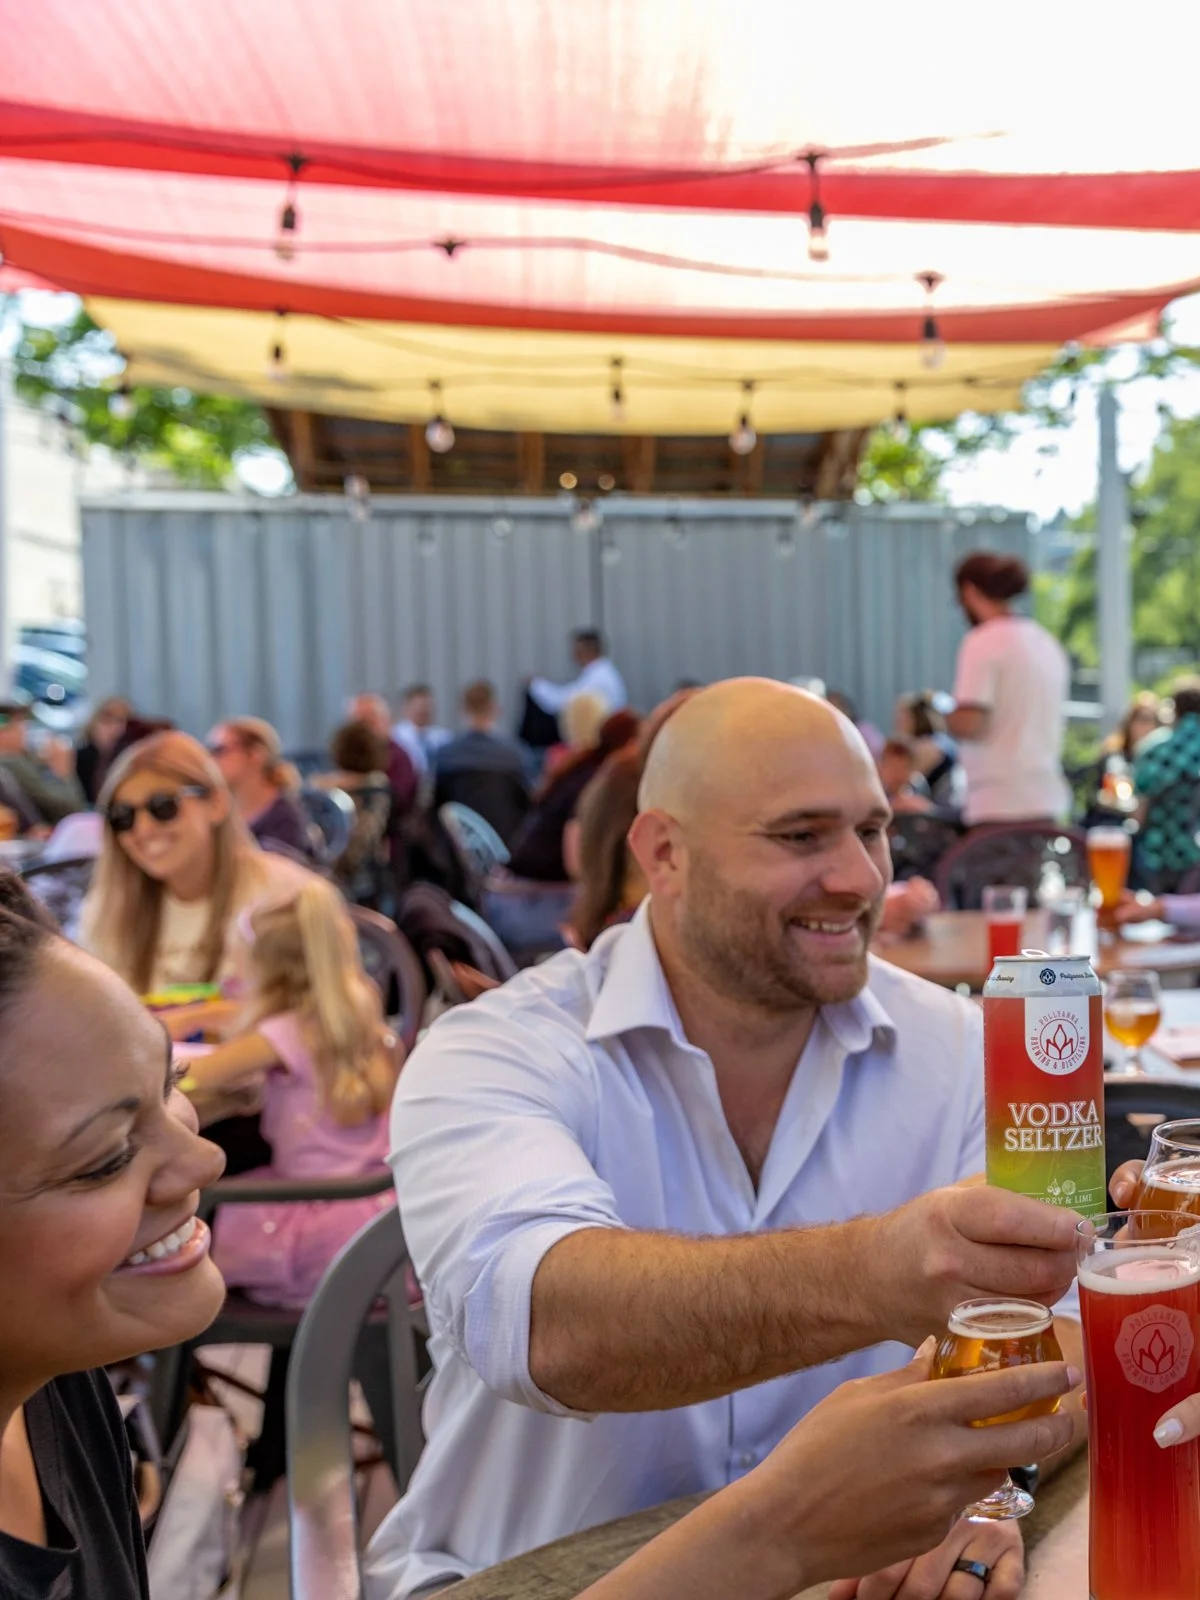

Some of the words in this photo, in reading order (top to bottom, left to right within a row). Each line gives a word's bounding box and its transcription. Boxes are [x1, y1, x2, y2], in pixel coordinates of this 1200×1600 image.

[1039, 1010, 1080, 1025] POLLYANNA
[1031, 1036, 1051, 1067] BREWING
[1061, 1036, 1086, 1069] DISTILLING
[1007, 1099, 1100, 1127] VODKA
[1004, 1125, 1103, 1152] SELTZER
[1065, 1196, 1072, 1204] &
[1074, 1193, 1093, 1204] LIME
[1129, 1310, 1182, 1331] POLLYANNA
[1121, 1352, 1155, 1386] BREWING
